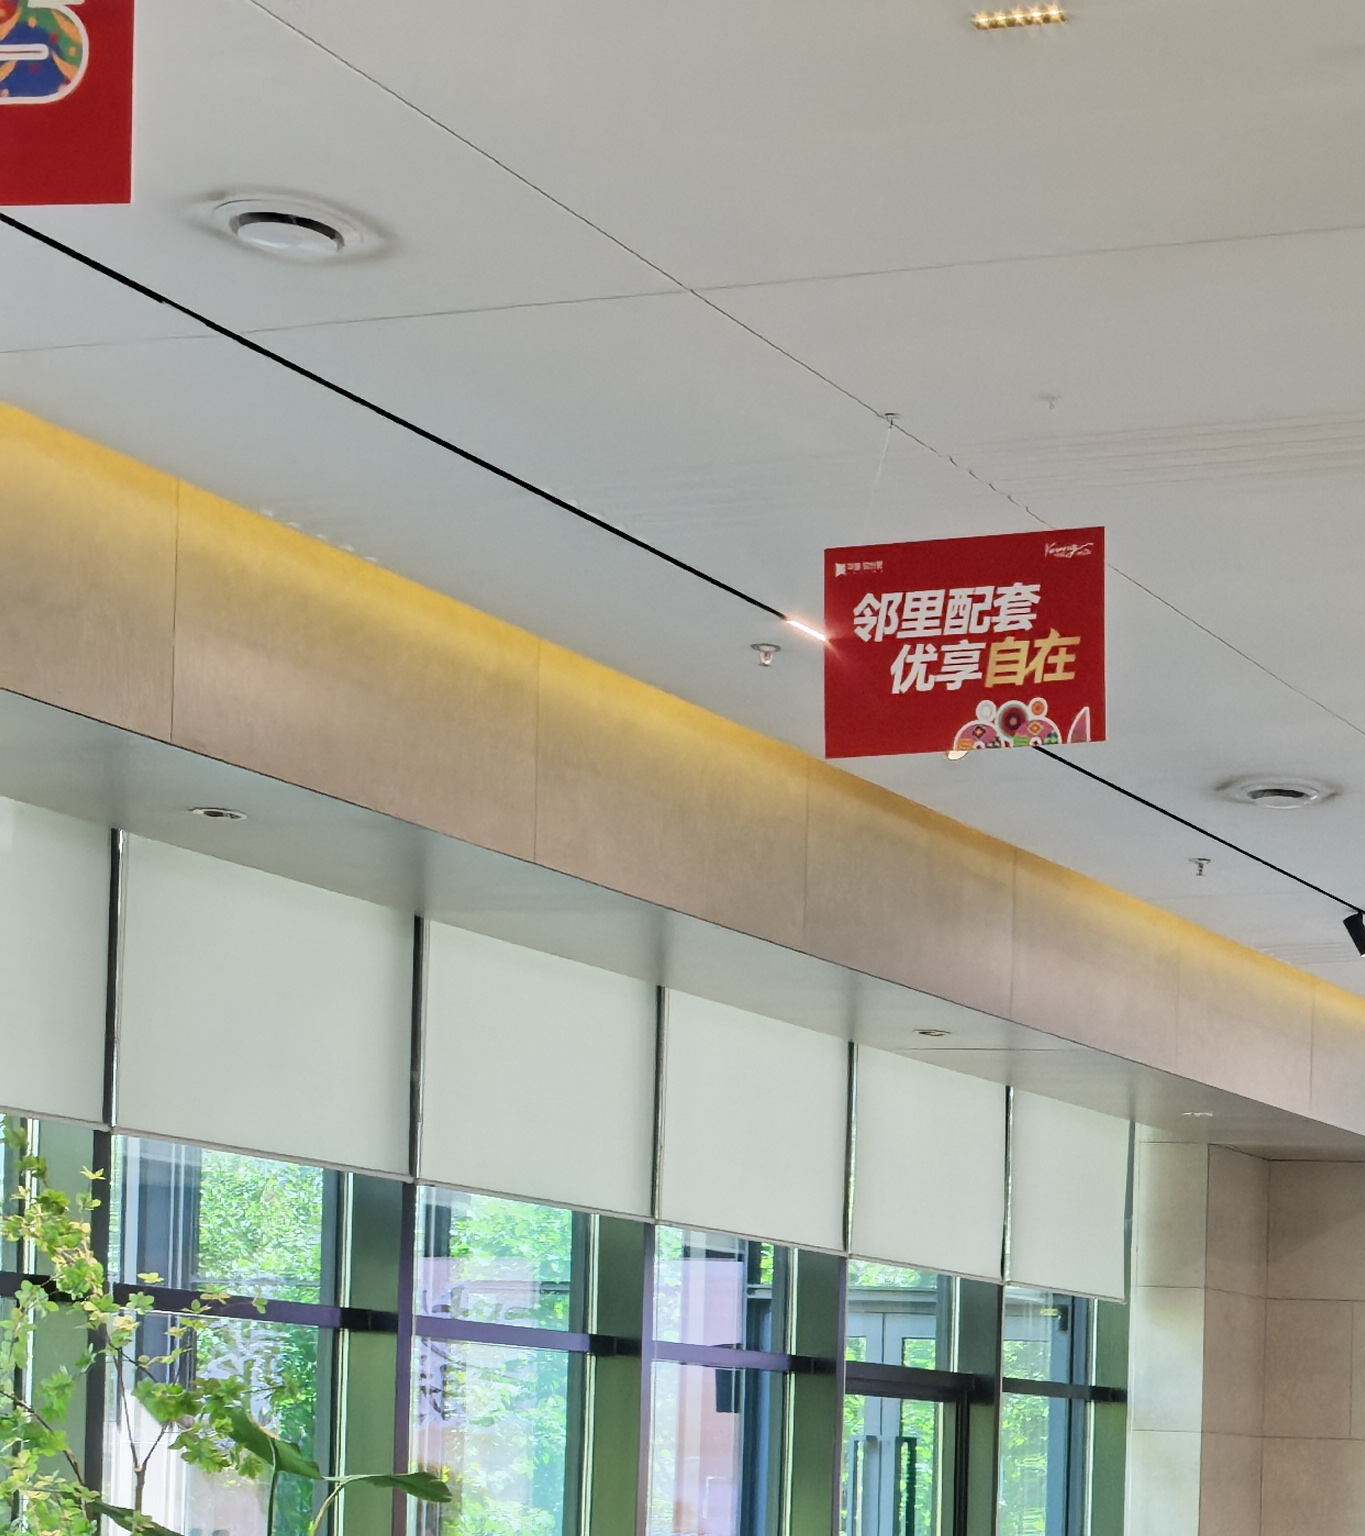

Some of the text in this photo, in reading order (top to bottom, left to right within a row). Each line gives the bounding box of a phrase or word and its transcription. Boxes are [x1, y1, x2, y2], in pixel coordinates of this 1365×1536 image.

[853, 582, 1041, 643] 邻里配套
[890, 628, 1081, 694] 优享自在
